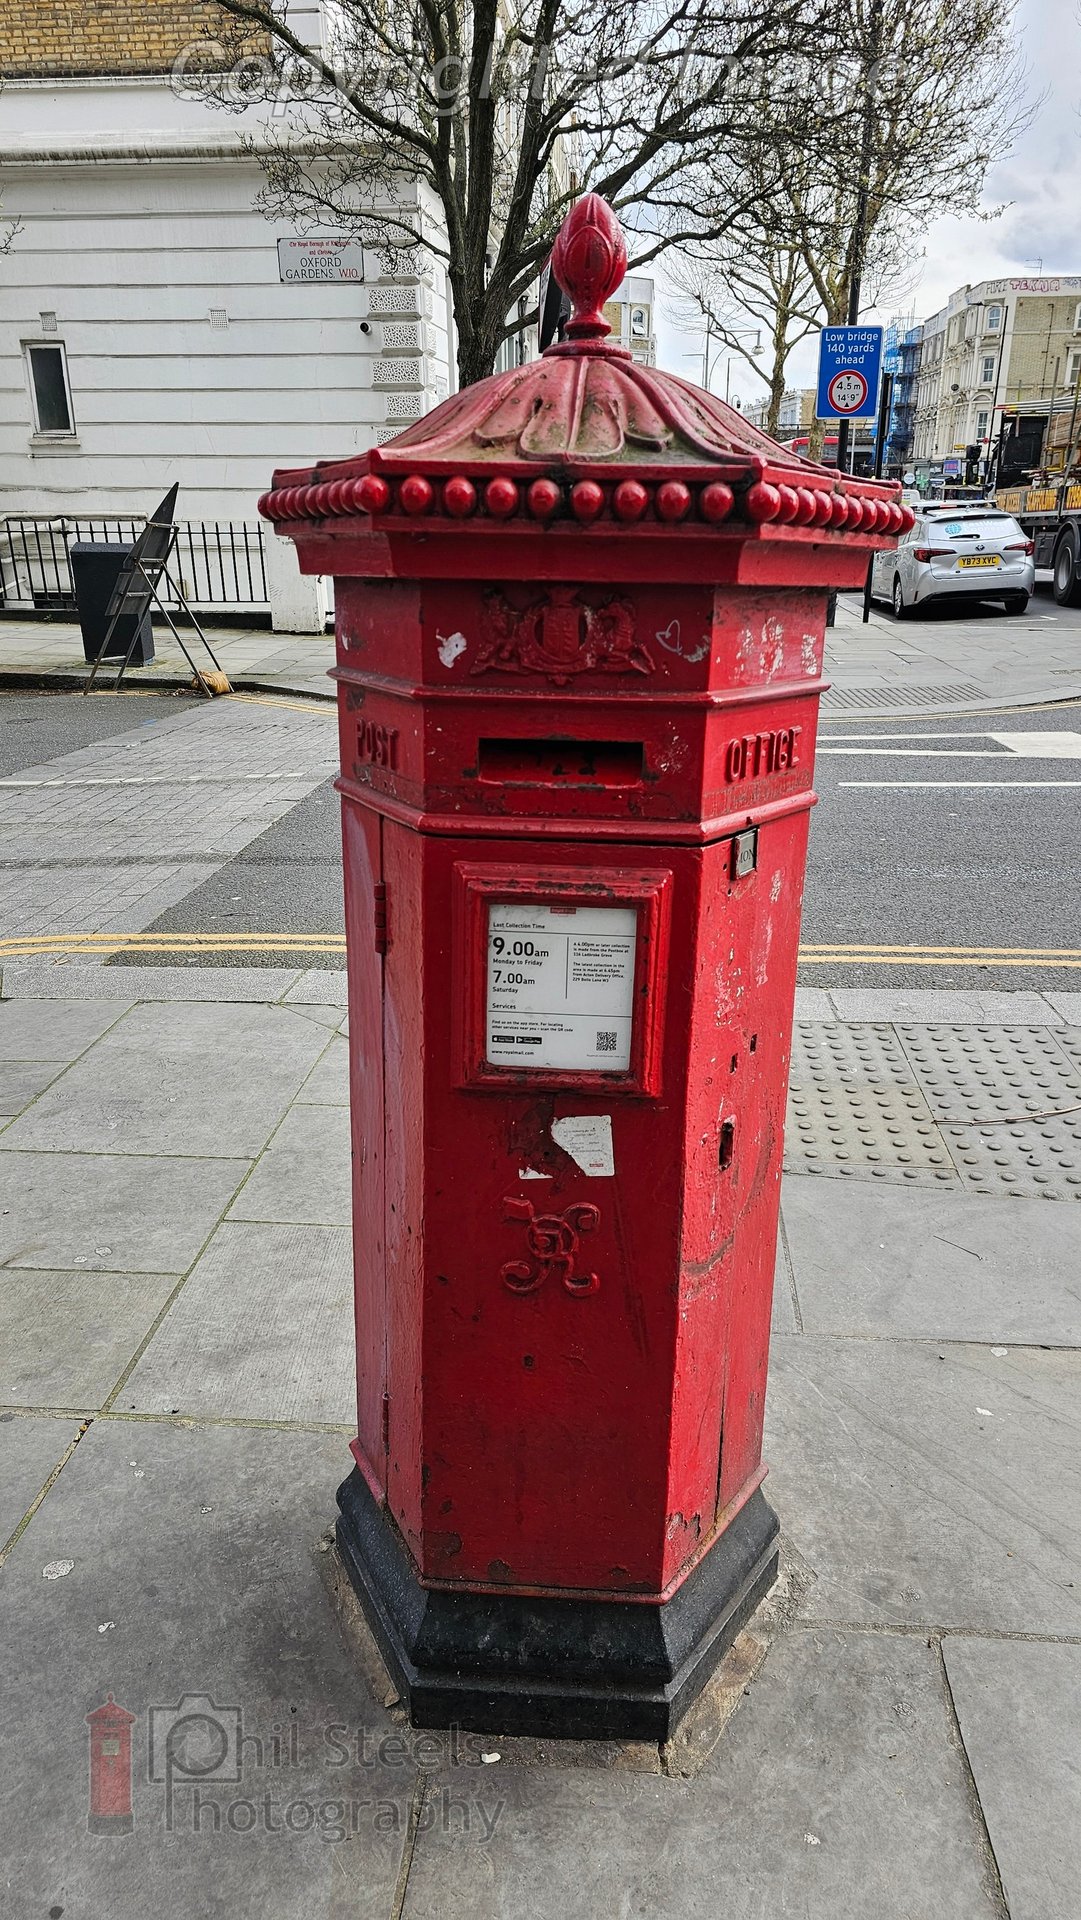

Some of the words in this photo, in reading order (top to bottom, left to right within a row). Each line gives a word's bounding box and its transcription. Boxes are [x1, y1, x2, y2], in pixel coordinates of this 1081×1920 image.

[300, 257, 342, 268] OXFORD
[825, 332, 844, 341] Low
[847, 331, 879, 343] bridge
[827, 343, 845, 353] 140
[848, 343, 875, 354] yards
[835, 355, 865, 364] ahead
[837, 382, 852, 390] 4.5
[962, 557, 980, 566] YB73
[982, 556, 996, 565] XVC
[357, 717, 399, 771] POST
[726, 725, 802, 783] OFFICE
[493, 937, 549, 958] 9.00am
[493, 970, 535, 985] 7.00am
